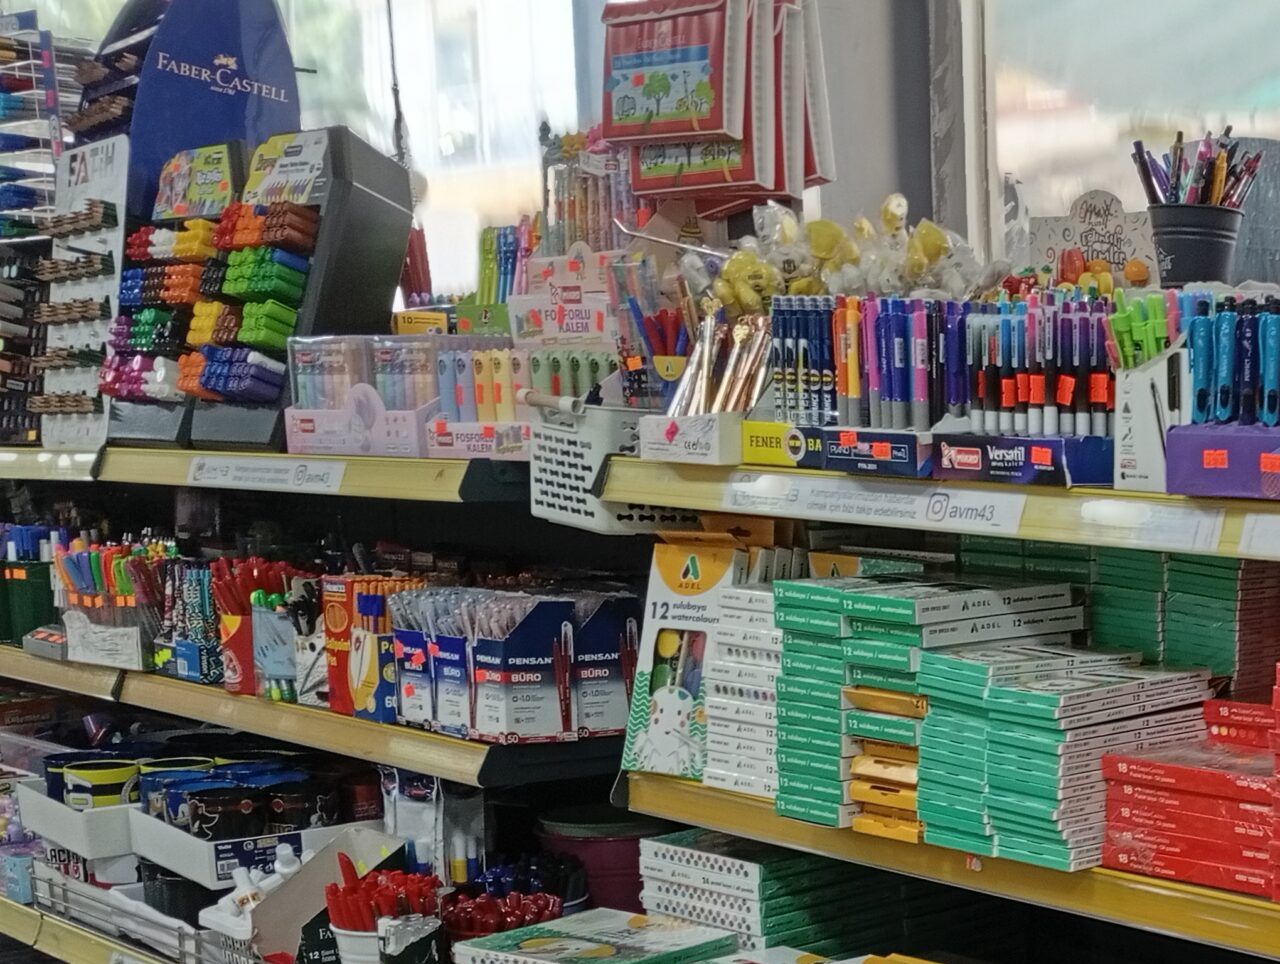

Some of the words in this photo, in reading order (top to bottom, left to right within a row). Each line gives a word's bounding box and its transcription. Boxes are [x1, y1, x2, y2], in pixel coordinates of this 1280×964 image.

[157, 53, 289, 102] FABER-CASTELL
[545, 308, 591, 323] FOFORLU
[750, 434, 783, 448] FENER
[986, 444, 1026, 462] Versatil
[949, 503, 1002, 528] avm43_
[678, 581, 701, 591] ADEL
[672, 601, 707, 613] suluboya
[843, 599, 853, 610] 12
[970, 600, 992, 609] ADEL
[1002, 596, 1012, 606] 12
[650, 601, 671, 621] 12
[1012, 618, 1023, 628] 12
[843, 646, 853, 657] 12
[508, 657, 553, 665] PENSAN
[578, 653, 619, 662] PENSAN
[511, 672, 542, 683] BÜRO
[581, 668, 609, 679] BÜRO
[507, 733, 519, 744] 50
[578, 728, 590, 738] 50
[1117, 762, 1128, 774] 18
